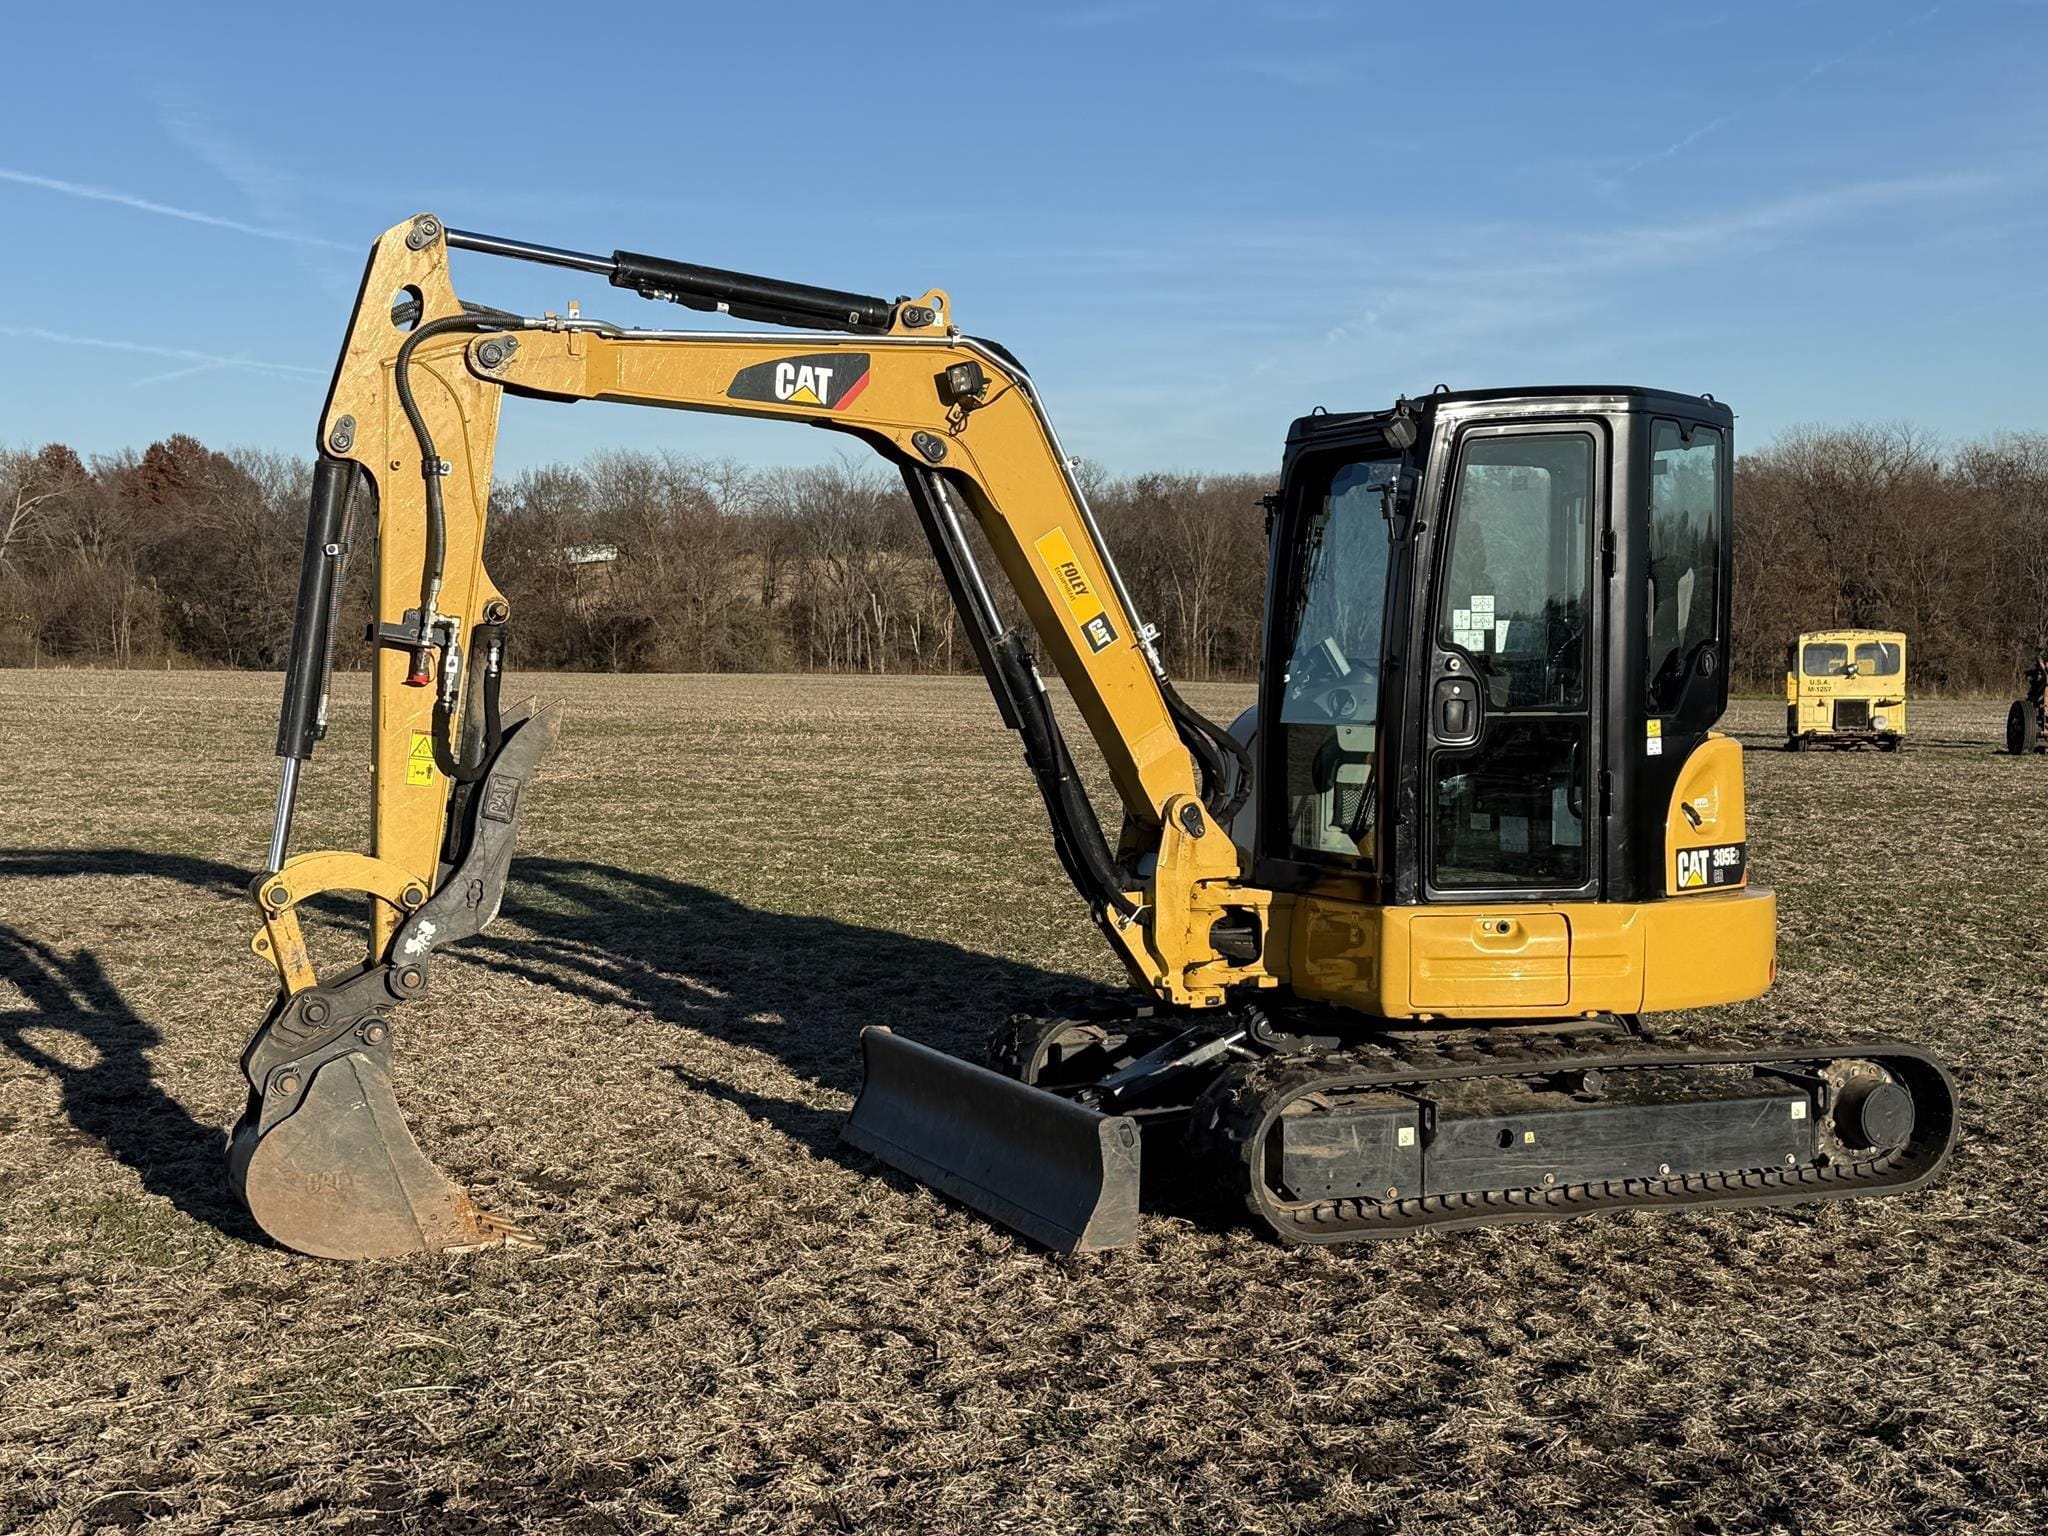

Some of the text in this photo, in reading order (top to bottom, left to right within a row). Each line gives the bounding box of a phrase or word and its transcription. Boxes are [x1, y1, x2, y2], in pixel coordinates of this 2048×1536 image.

[775, 362, 833, 404] CAT
[1055, 567, 1076, 601] EQUIPMENT
[1061, 562, 1089, 596] FOLEY
[1088, 618, 1112, 646] CAT
[488, 779, 515, 816] CAT
[1677, 849, 1709, 887] CAT
